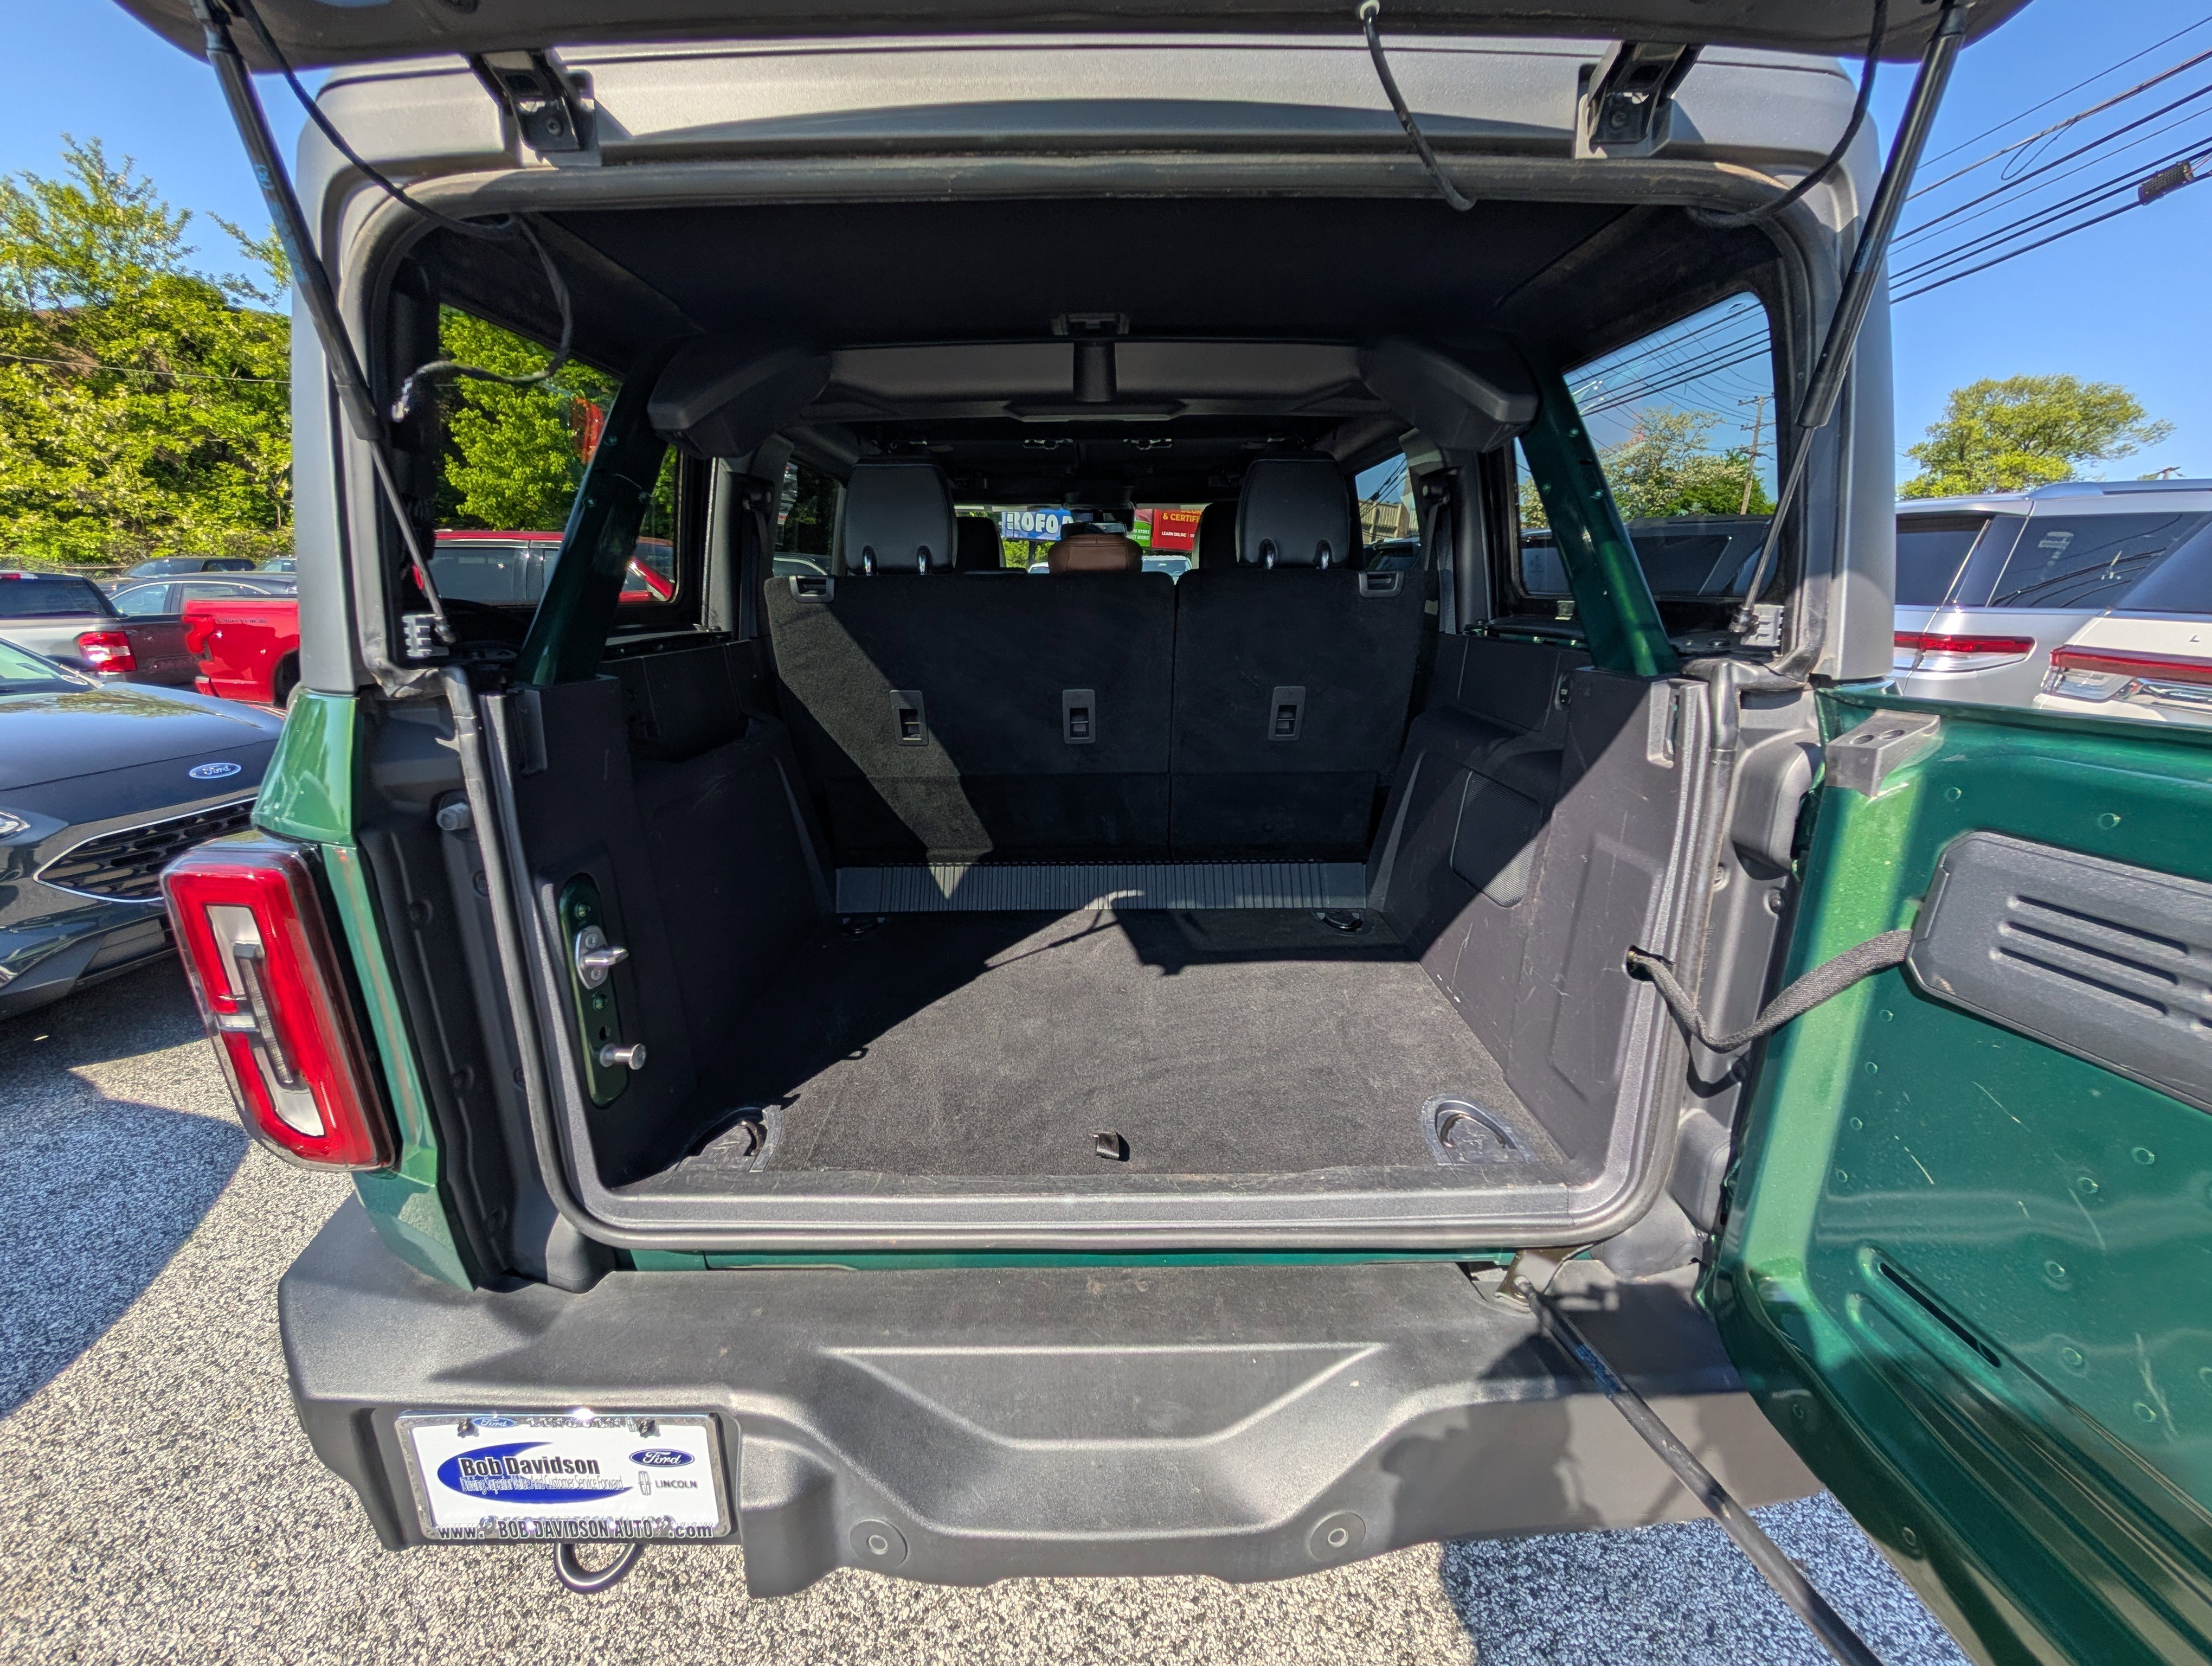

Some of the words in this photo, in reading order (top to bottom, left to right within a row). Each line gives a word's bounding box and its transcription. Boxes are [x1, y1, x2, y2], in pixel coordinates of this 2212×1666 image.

[203, 765, 231, 775] Ford
[480, 1418, 508, 1427] Ford
[526, 1418, 620, 1428] LINCOLN
[642, 1451, 681, 1465] Ford
[458, 1457, 503, 1476] Bob
[507, 1456, 600, 1475] Davidson
[460, 1476, 486, 1495] Driving
[544, 1475, 574, 1490] Customer
[574, 1475, 597, 1489] Service
[597, 1476, 623, 1490] Forward
[655, 1480, 698, 1489] LINCOLN
[498, 1520, 529, 1539] BOB
[534, 1520, 609, 1539] DAVIDSON
[615, 1520, 654, 1539] AUTO
